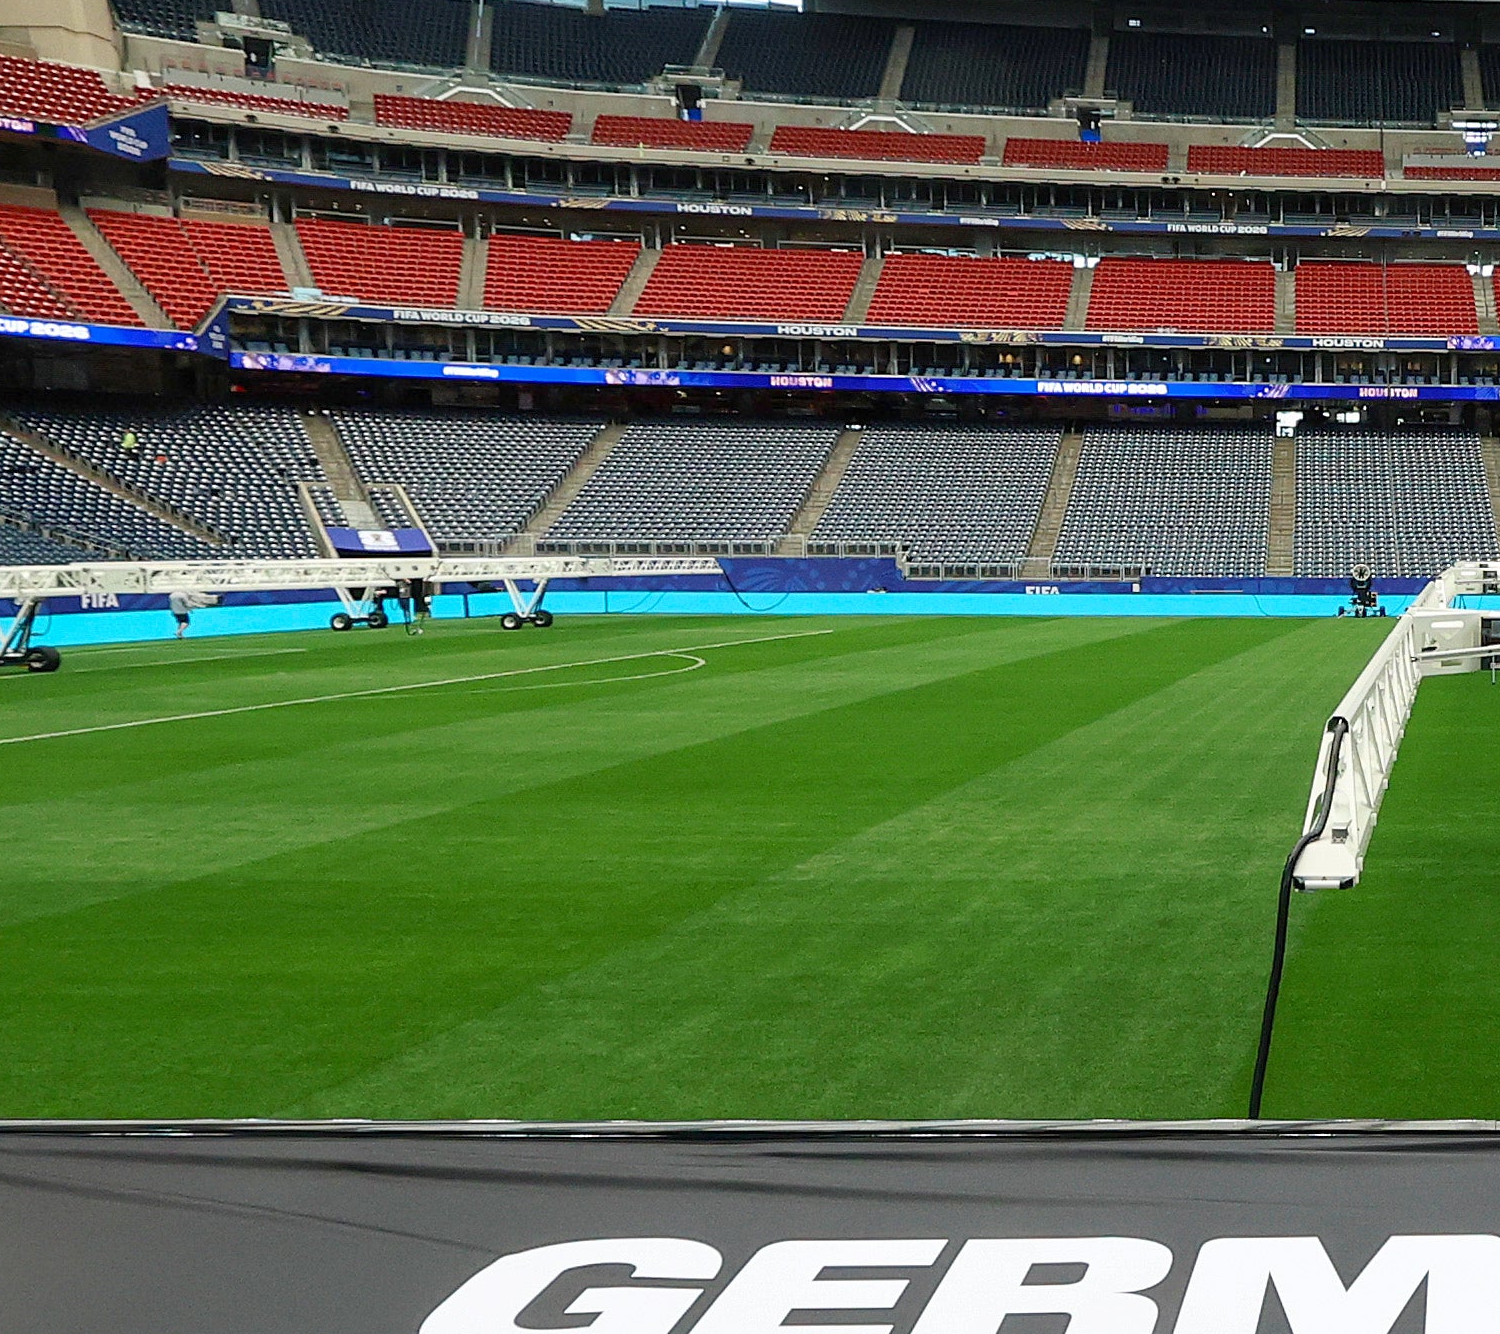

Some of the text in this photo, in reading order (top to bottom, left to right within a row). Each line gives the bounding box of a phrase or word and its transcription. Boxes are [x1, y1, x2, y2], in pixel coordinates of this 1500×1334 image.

[350, 180, 479, 199] FIFA WORLD CUP 2026
[676, 203, 753, 215] HOUSTON
[1167, 224, 1268, 235] FIFA WORLD CUP 2026
[393, 310, 531, 325] FIFA WORLD CUP 2026
[30, 322, 90, 340] 2026
[777, 326, 857, 336] HOUSTON
[1312, 339, 1384, 348] HOUSTON
[770, 376, 833, 388] HOUSTON
[1037, 382, 1062, 393] FIFA
[1062, 383, 1103, 393] WORLD
[1104, 383, 1127, 394] CUP
[81, 593, 120, 609] FIFA
